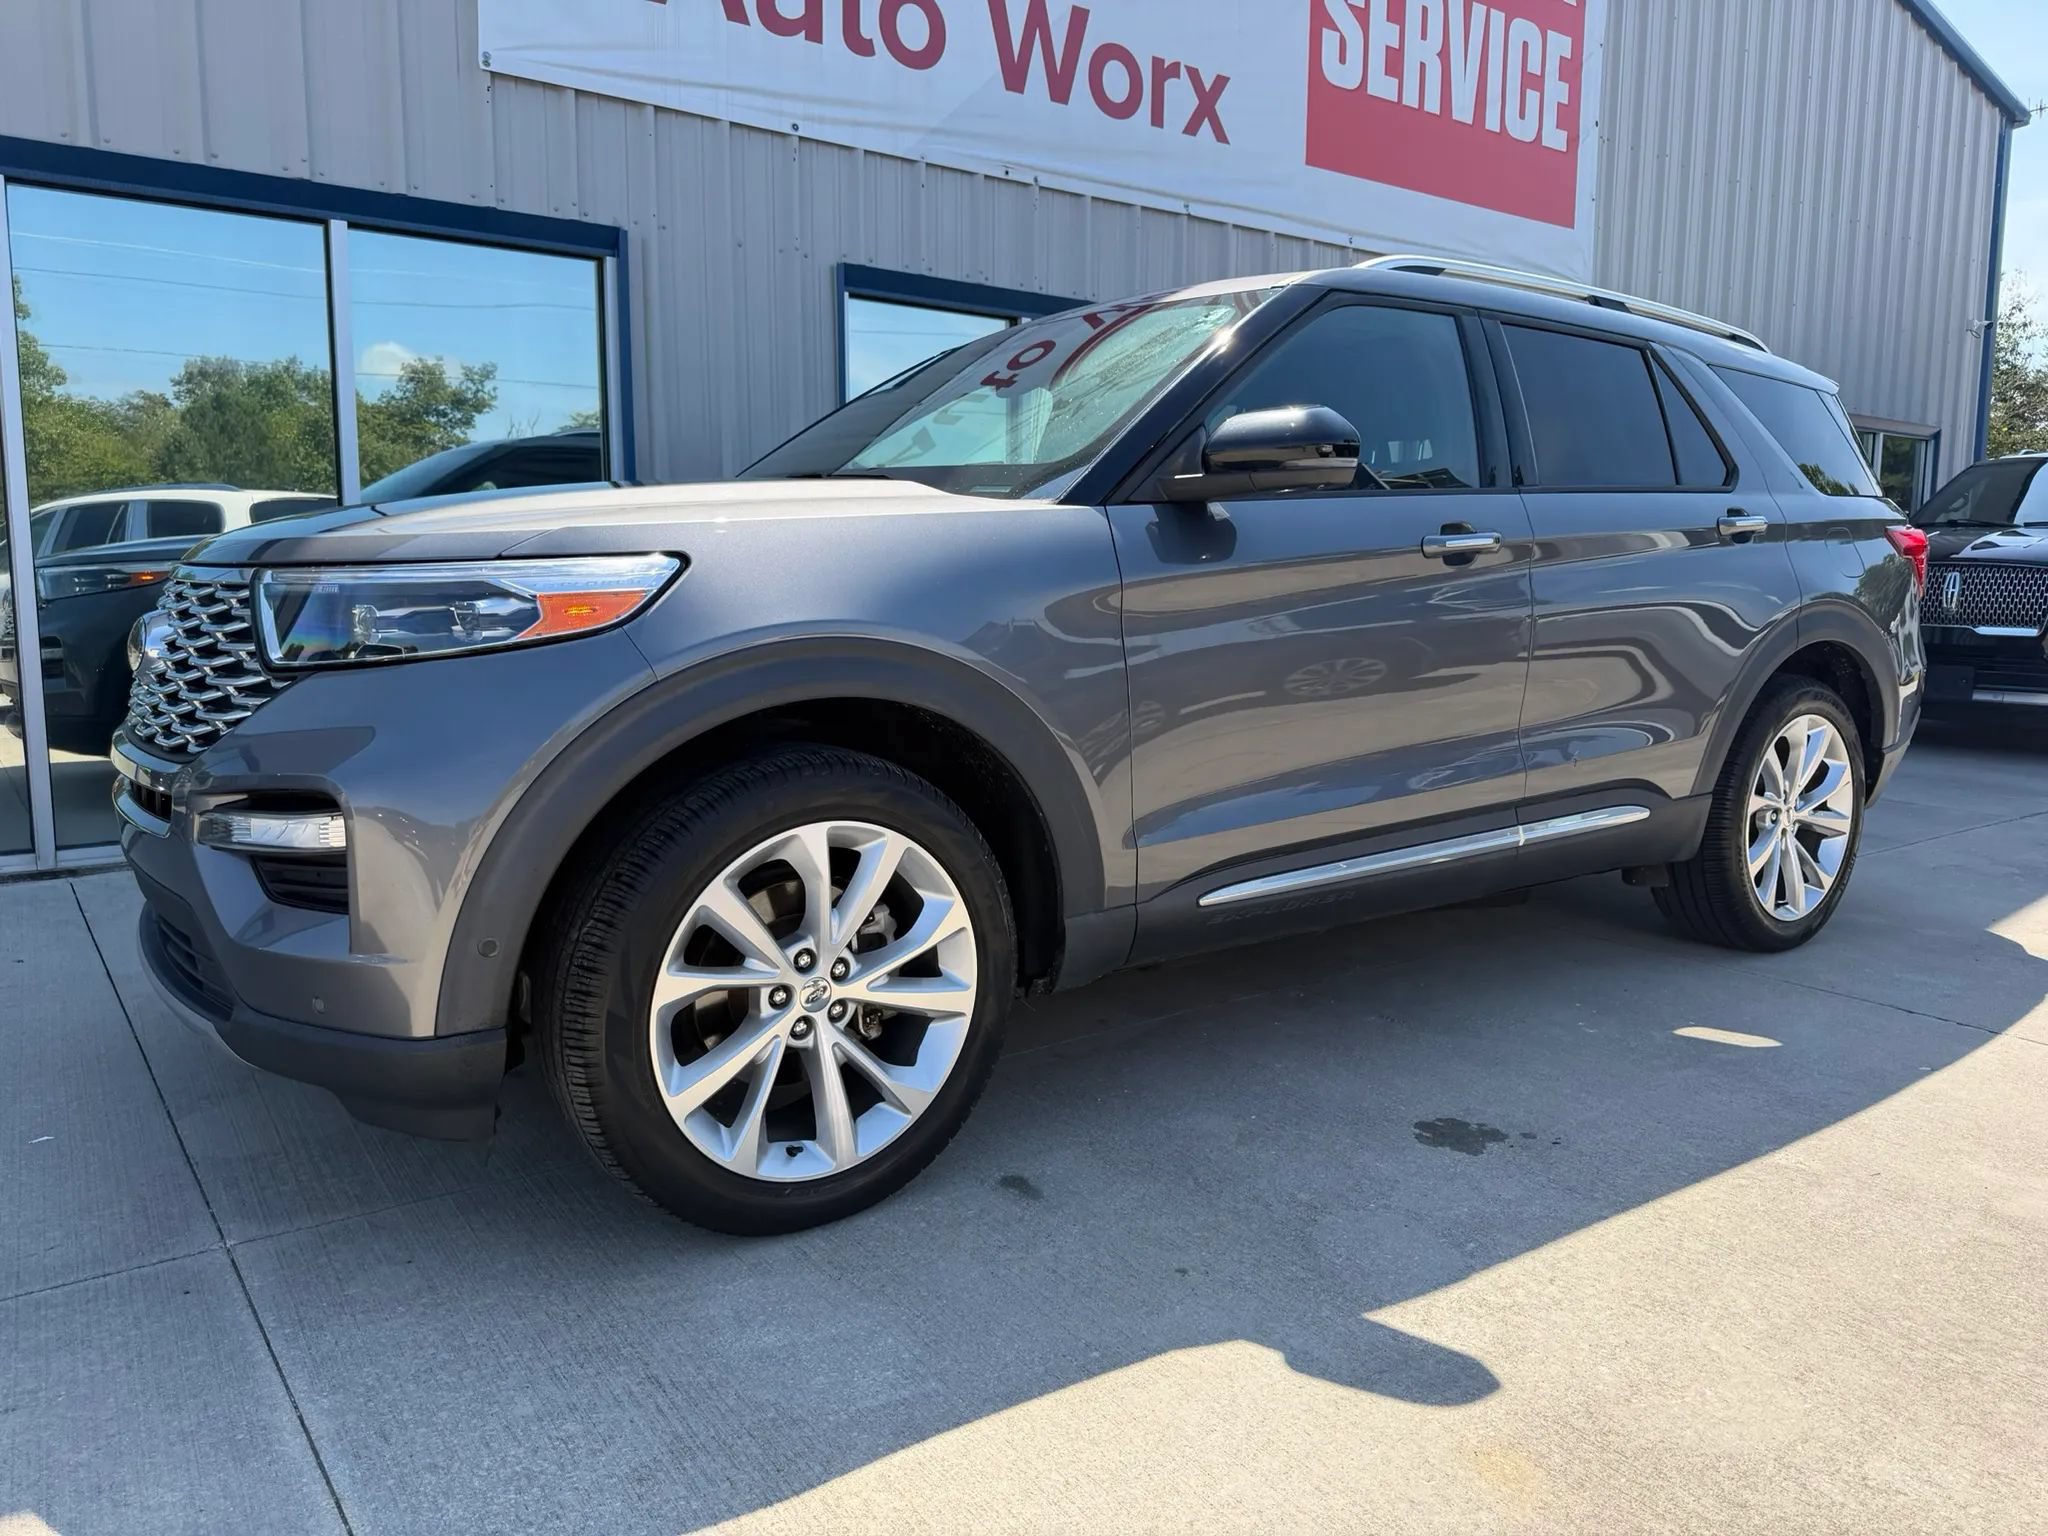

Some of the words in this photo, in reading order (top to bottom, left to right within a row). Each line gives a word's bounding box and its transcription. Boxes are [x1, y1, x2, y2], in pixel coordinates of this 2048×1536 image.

[645, 0, 947, 70] uto
[988, 0, 1231, 145] Worx
[1321, 0, 1572, 152] SERVICE
